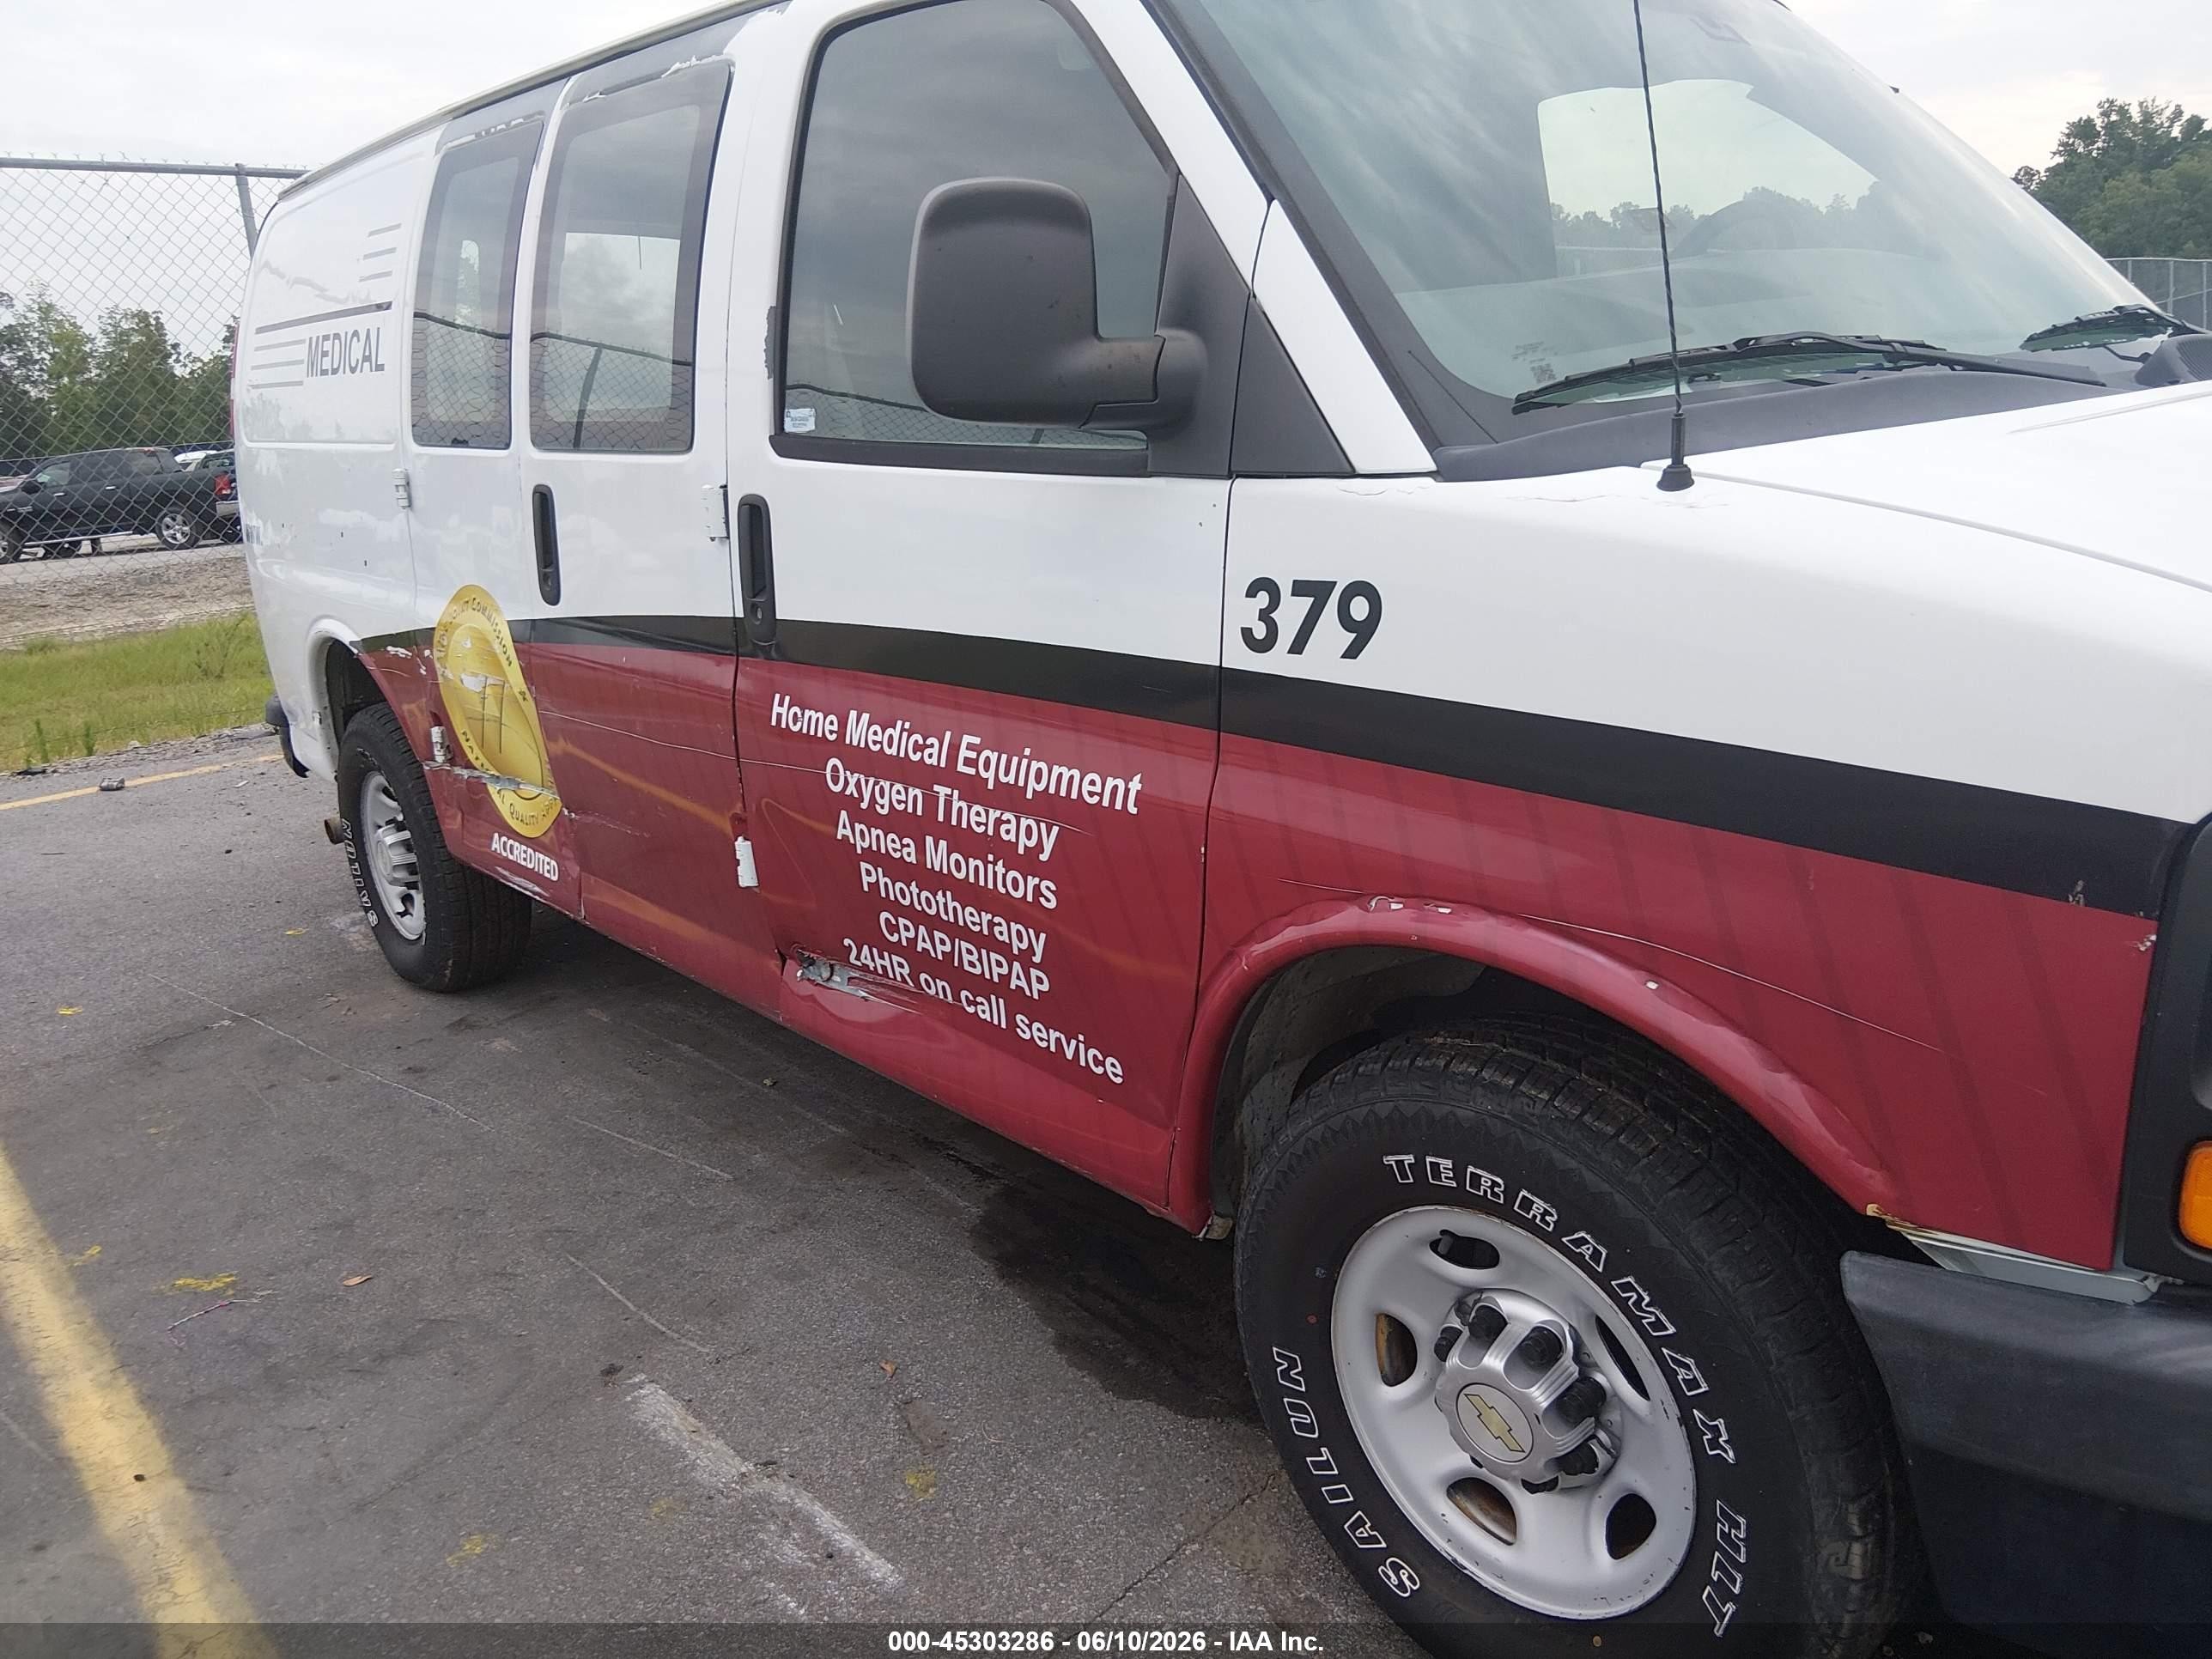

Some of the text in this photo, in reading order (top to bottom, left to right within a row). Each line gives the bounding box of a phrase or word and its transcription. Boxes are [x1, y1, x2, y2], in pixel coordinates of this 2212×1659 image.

[306, 327, 385, 378] MEDICAL
[1240, 576, 1382, 659] 379
[770, 693, 1142, 815] Home Medical Equipment
[491, 832, 559, 882] ACCREDITED
[825, 757, 1060, 862] Oxygen Therapy
[836, 810, 1058, 910] Apnea Monitors
[860, 860, 1046, 964] Phototherapy
[879, 910, 1050, 1000] CPAP/BIPAP
[842, 938, 1125, 1085] 24HR on call service
[1382, 1153, 1747, 1638] TERRAMAX HLT
[1273, 1346, 1422, 1598] SAILUN
